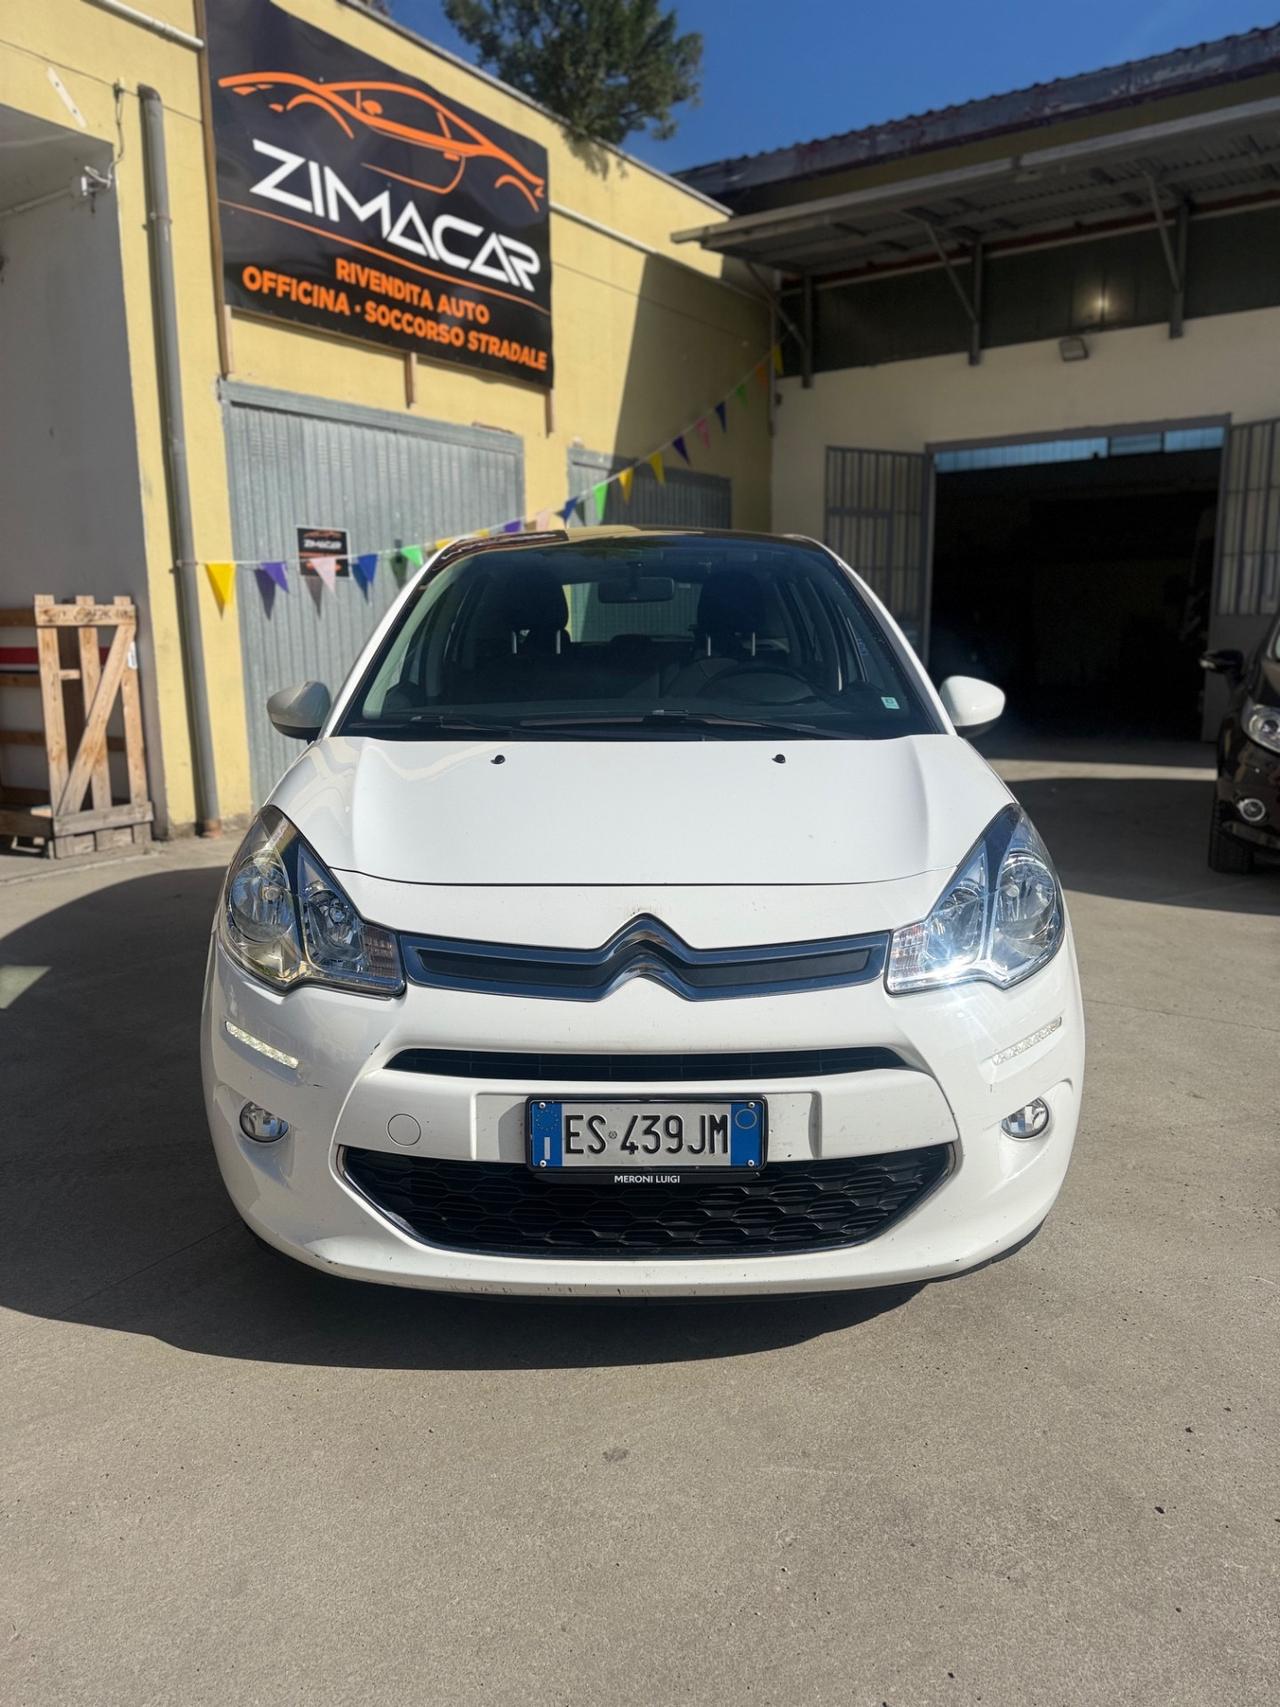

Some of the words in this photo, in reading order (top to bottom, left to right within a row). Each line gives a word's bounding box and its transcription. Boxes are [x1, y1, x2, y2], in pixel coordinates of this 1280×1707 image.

[249, 138, 541, 292] ZIMACAR
[242, 265, 351, 316] OFFICINA
[365, 300, 465, 348] SOCCORSO
[467, 330, 548, 371] STRADALE
[335, 257, 434, 313] RIVENDITA
[437, 294, 490, 325] AUTO
[564, 1114, 608, 1155] ES
[620, 1114, 729, 1156] 439JM
[614, 1175, 654, 1184] MERONI
[656, 1175, 680, 1184] LUIGI
